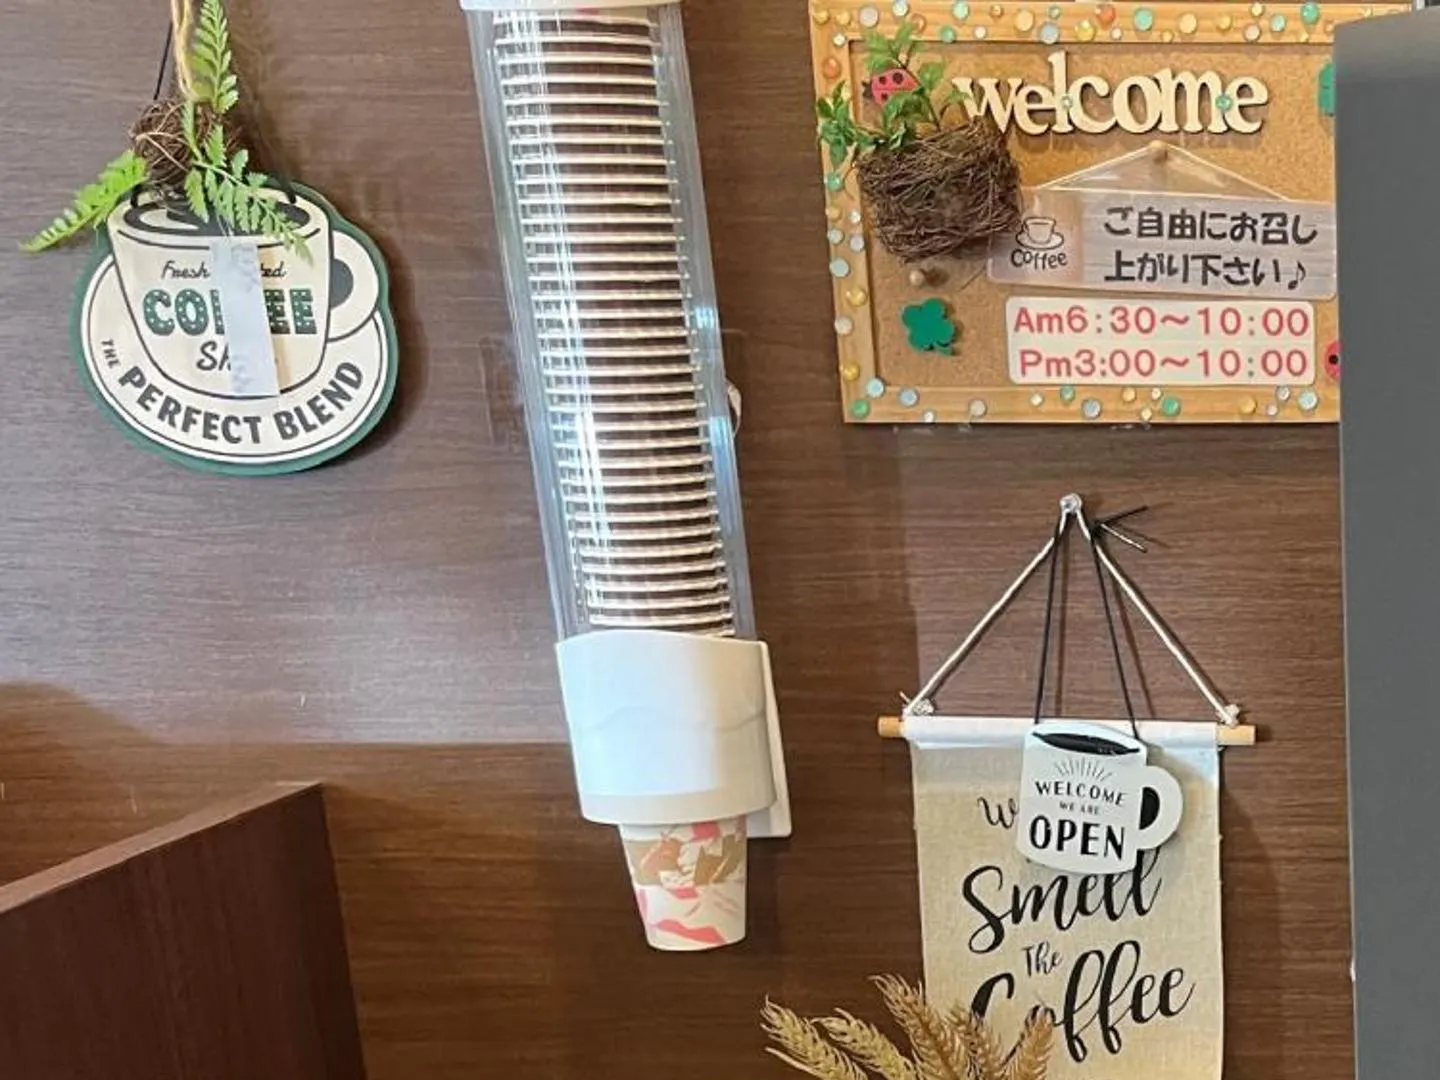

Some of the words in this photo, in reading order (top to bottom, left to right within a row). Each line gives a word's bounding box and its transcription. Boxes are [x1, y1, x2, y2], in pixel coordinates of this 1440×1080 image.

[952, 50, 1269, 135] welcome
[1104, 206, 1318, 246] ご自由にお召し
[1010, 247, 1068, 271] Coffee
[143, 287, 318, 336] COEE
[100, 338, 120, 370] THE
[118, 364, 262, 444] PERFECT
[273, 361, 365, 441] BLEND
[1035, 781, 1128, 807] WELCOME
[1030, 815, 1125, 861] OPEN
[962, 849, 1162, 955] Smell
[1023, 941, 1064, 977] The
